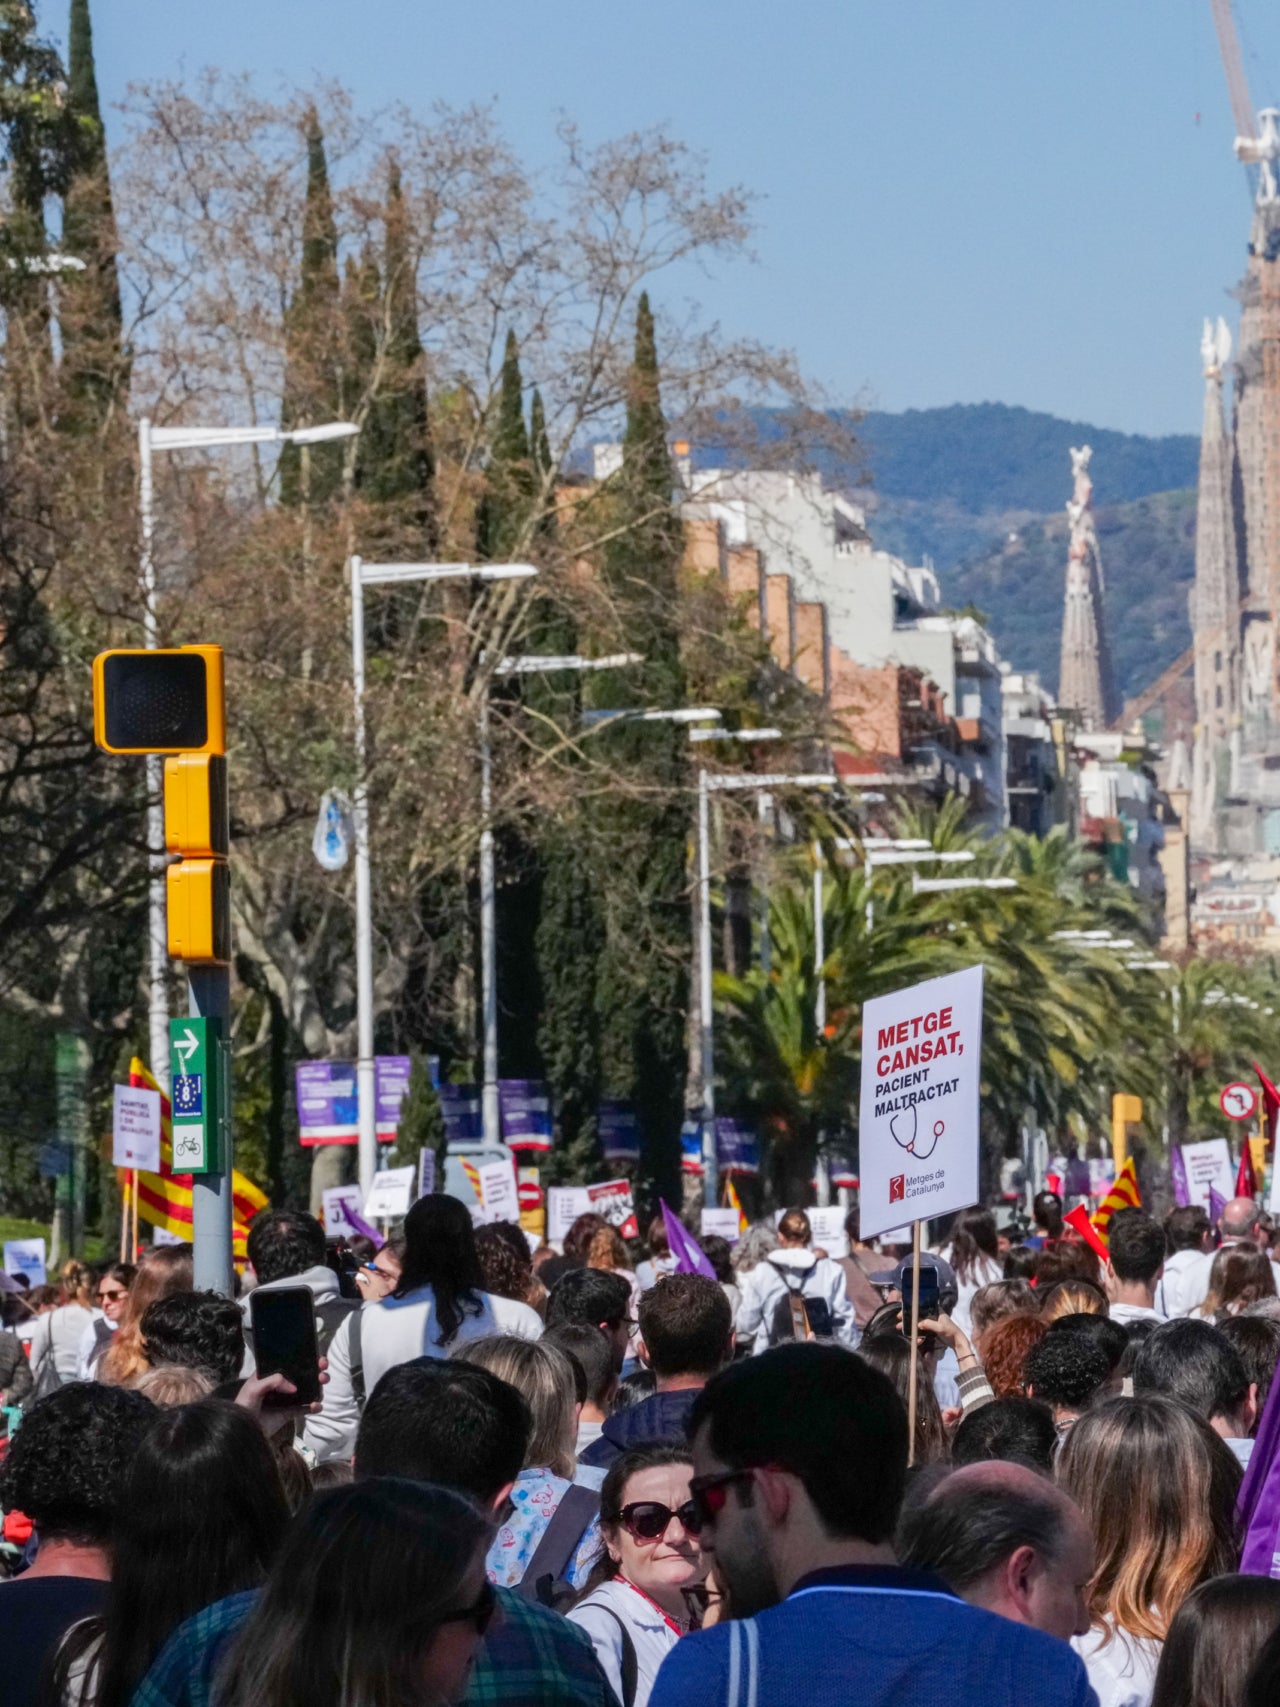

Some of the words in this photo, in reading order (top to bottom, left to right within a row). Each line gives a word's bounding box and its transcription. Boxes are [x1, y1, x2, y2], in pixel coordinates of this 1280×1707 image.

[878, 1006, 952, 1051] METGE
[877, 1030, 964, 1077] CANSAT,
[182, 1086, 190, 1102] 8
[874, 1078, 959, 1118] MALTRACTAT
[875, 1068, 930, 1098] PACIENT
[906, 1174, 934, 1188] Metges
[935, 1169, 945, 1179] de
[906, 1180, 945, 1199] Catalunya
